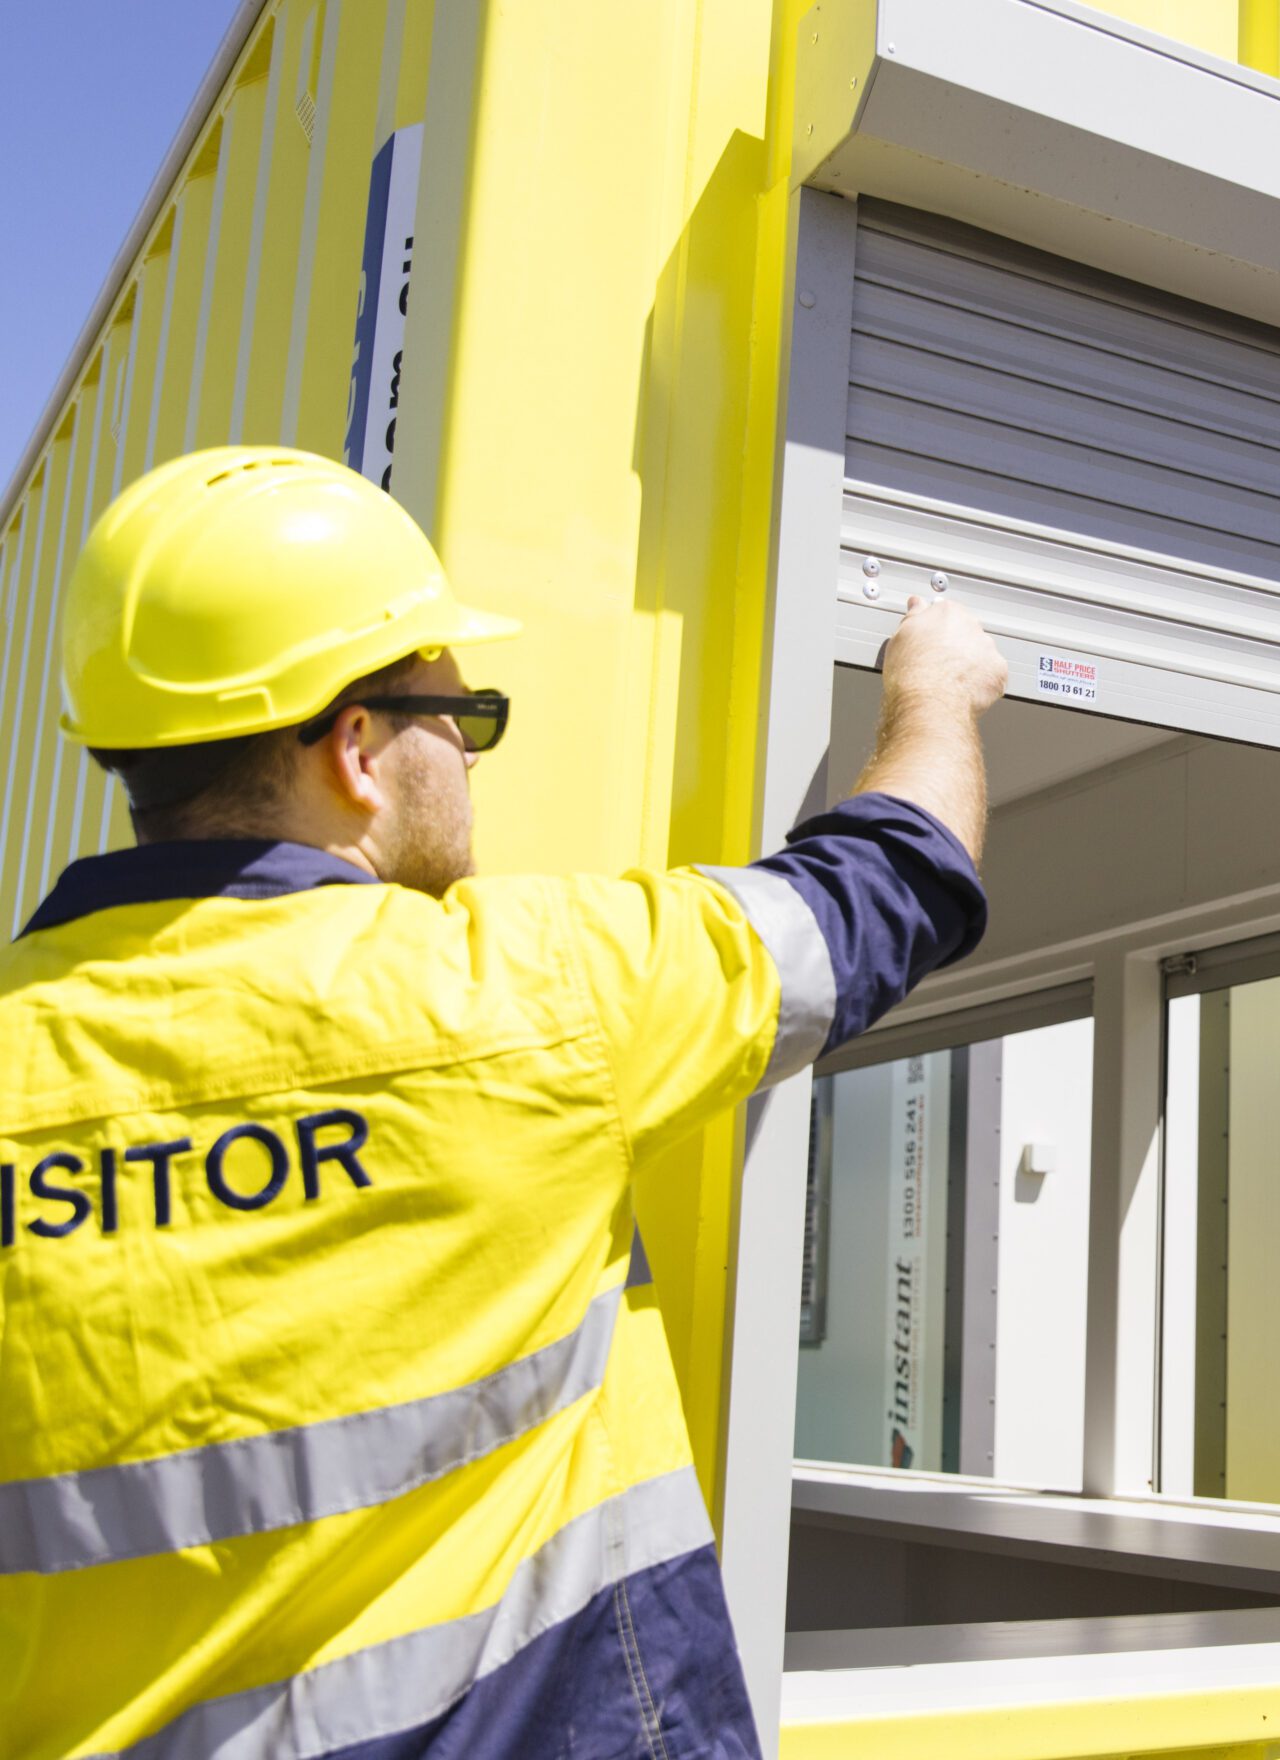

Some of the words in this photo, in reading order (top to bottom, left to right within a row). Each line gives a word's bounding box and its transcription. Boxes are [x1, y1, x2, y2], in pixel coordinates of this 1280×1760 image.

[1054, 659, 1072, 670] HALF
[1075, 663, 1096, 674] PRICE
[1054, 667, 1095, 680] SHUTTERS
[1039, 680, 1059, 691] 1800
[1061, 684, 1071, 694] 13
[1073, 686, 1083, 696] 61
[1085, 689, 1095, 698] 21
[905, 1096, 917, 1134] 241
[903, 1187, 915, 1240] 1300
[888, 1256, 915, 1430] instant
